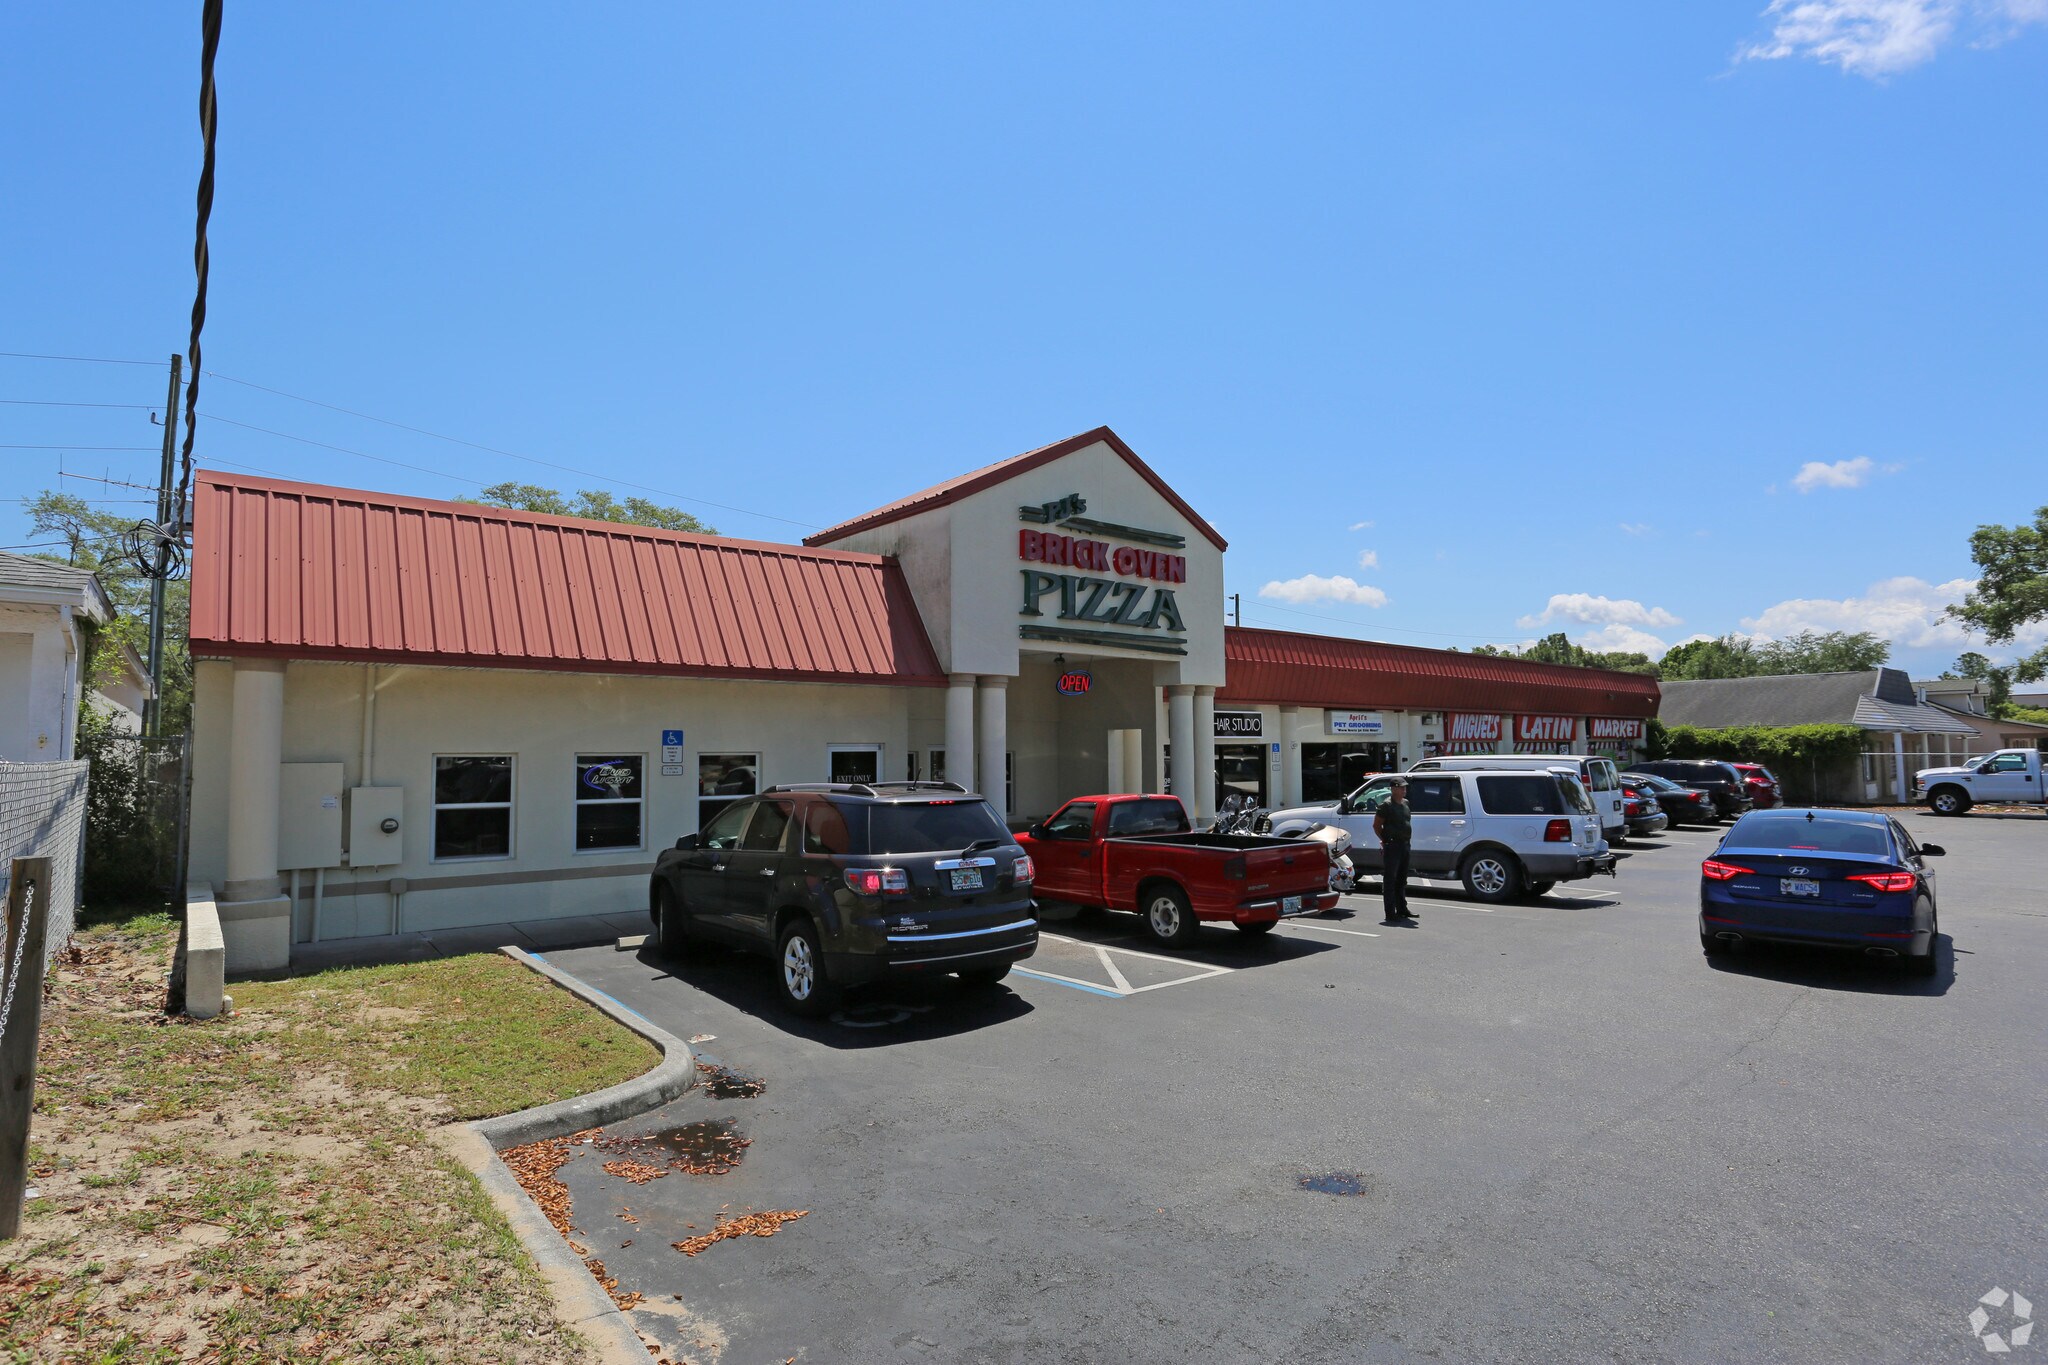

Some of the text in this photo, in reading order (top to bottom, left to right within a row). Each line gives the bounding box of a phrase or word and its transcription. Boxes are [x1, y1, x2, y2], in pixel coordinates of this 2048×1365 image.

[1019, 529, 1186, 583] BRICK OVEN
[1019, 569, 1187, 632] PIZZA
[1061, 674, 1090, 692] OPEN
[1232, 717, 1261, 732] STUDIO
[1520, 715, 1574, 740] LATIN
[1593, 719, 1640, 738] MARKET
[836, 774, 871, 783] EXIT ONLY
